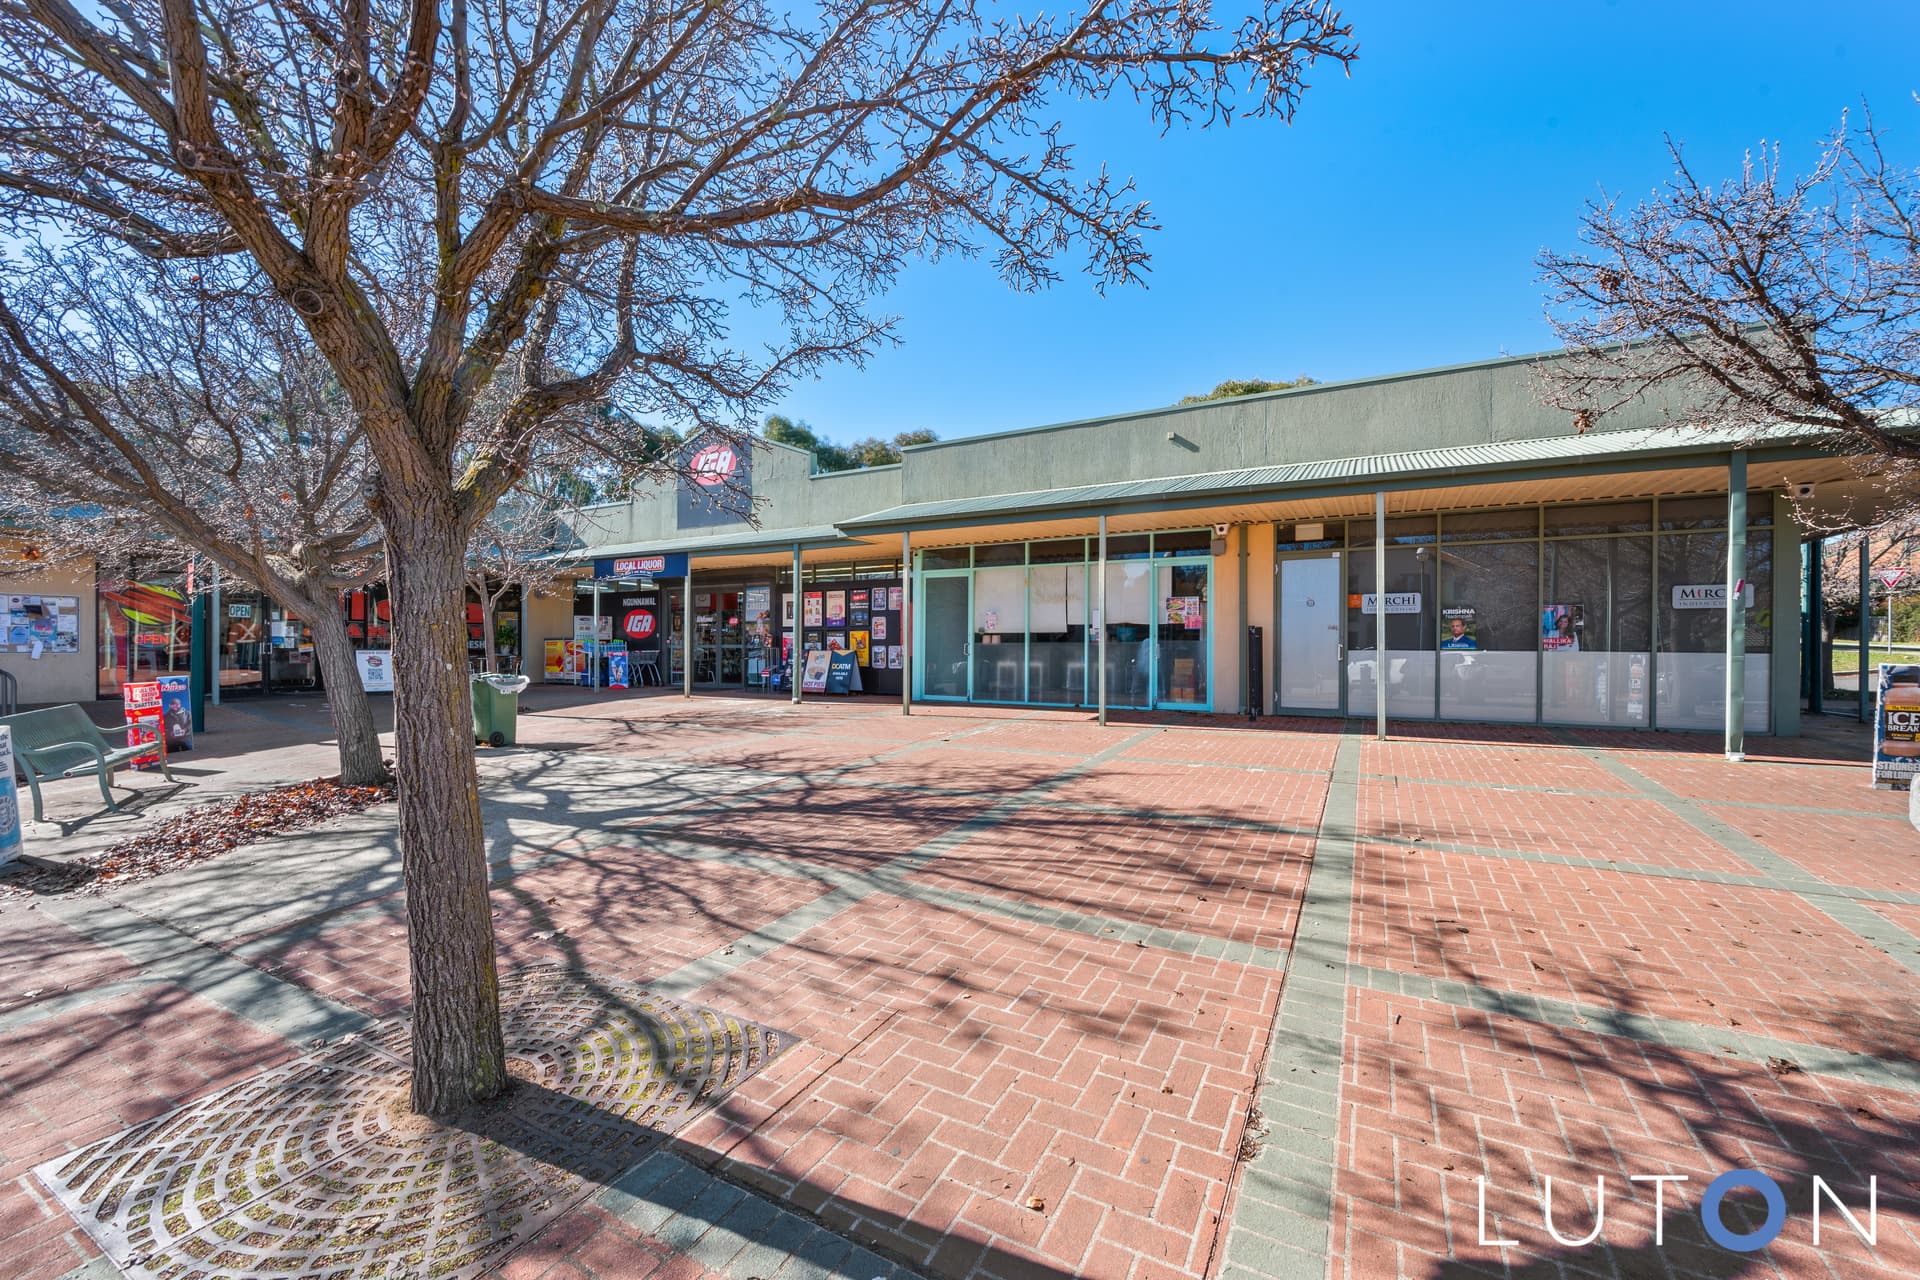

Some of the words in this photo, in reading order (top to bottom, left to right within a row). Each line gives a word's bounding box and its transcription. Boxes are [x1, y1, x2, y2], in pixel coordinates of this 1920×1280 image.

[697, 451, 732, 474] IGA
[616, 561, 636, 570] LOCAL
[637, 559, 662, 569] LIQUOR
[1680, 588, 1727, 599] MIRC
[1367, 594, 1416, 606] MRCHI
[230, 605, 250, 616] OPEN
[626, 615, 653, 632] IGA
[134, 634, 169, 645] OPEN
[1888, 711, 1920, 726] ICE
[1877, 761, 1920, 771] STRONGE
